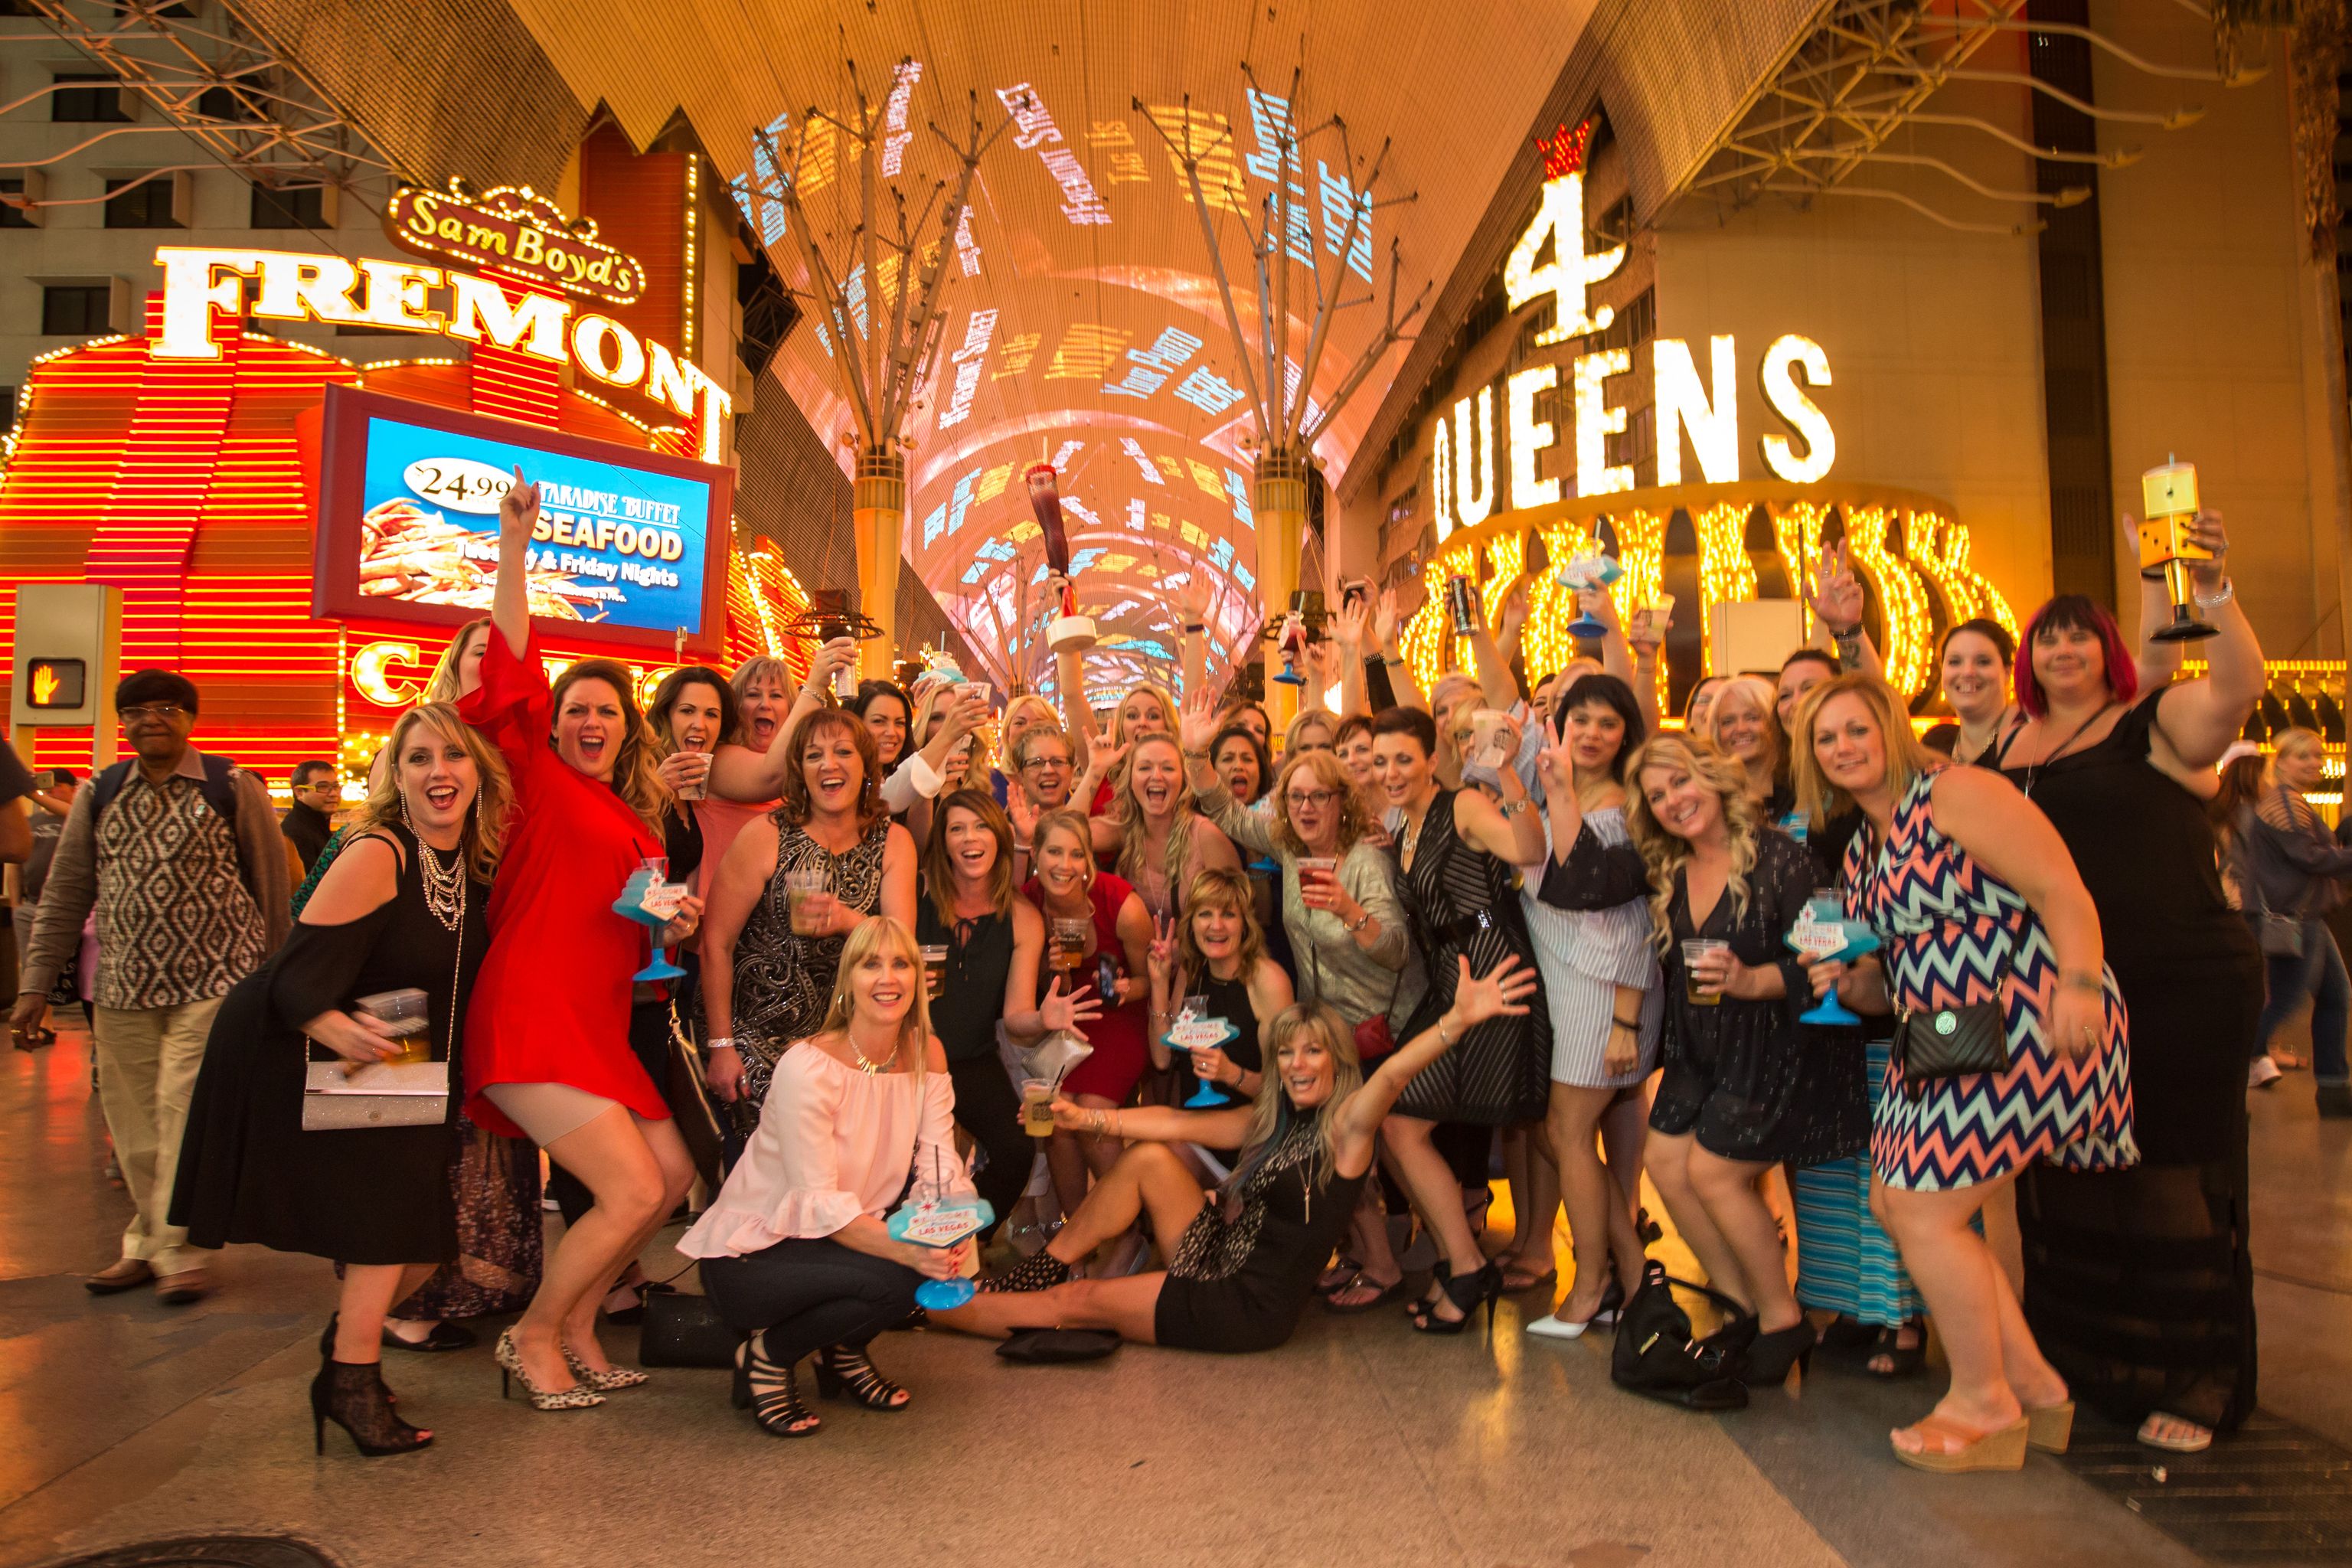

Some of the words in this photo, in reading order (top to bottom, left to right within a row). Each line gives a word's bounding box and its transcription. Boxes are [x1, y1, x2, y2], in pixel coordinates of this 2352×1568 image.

[407, 196, 508, 256] Sam
[512, 226, 632, 292] Boyd's
[1504, 172, 1627, 347] 4
[150, 247, 732, 464] FREMONT
[1433, 333, 1836, 545] QUEENS
[531, 509, 683, 561] SEAFOOD
[560, 552, 618, 583] Friday
[621, 562, 679, 588] Nights
[919, 1227, 936, 1236] LAS
[938, 1221, 969, 1233] VEGAS
